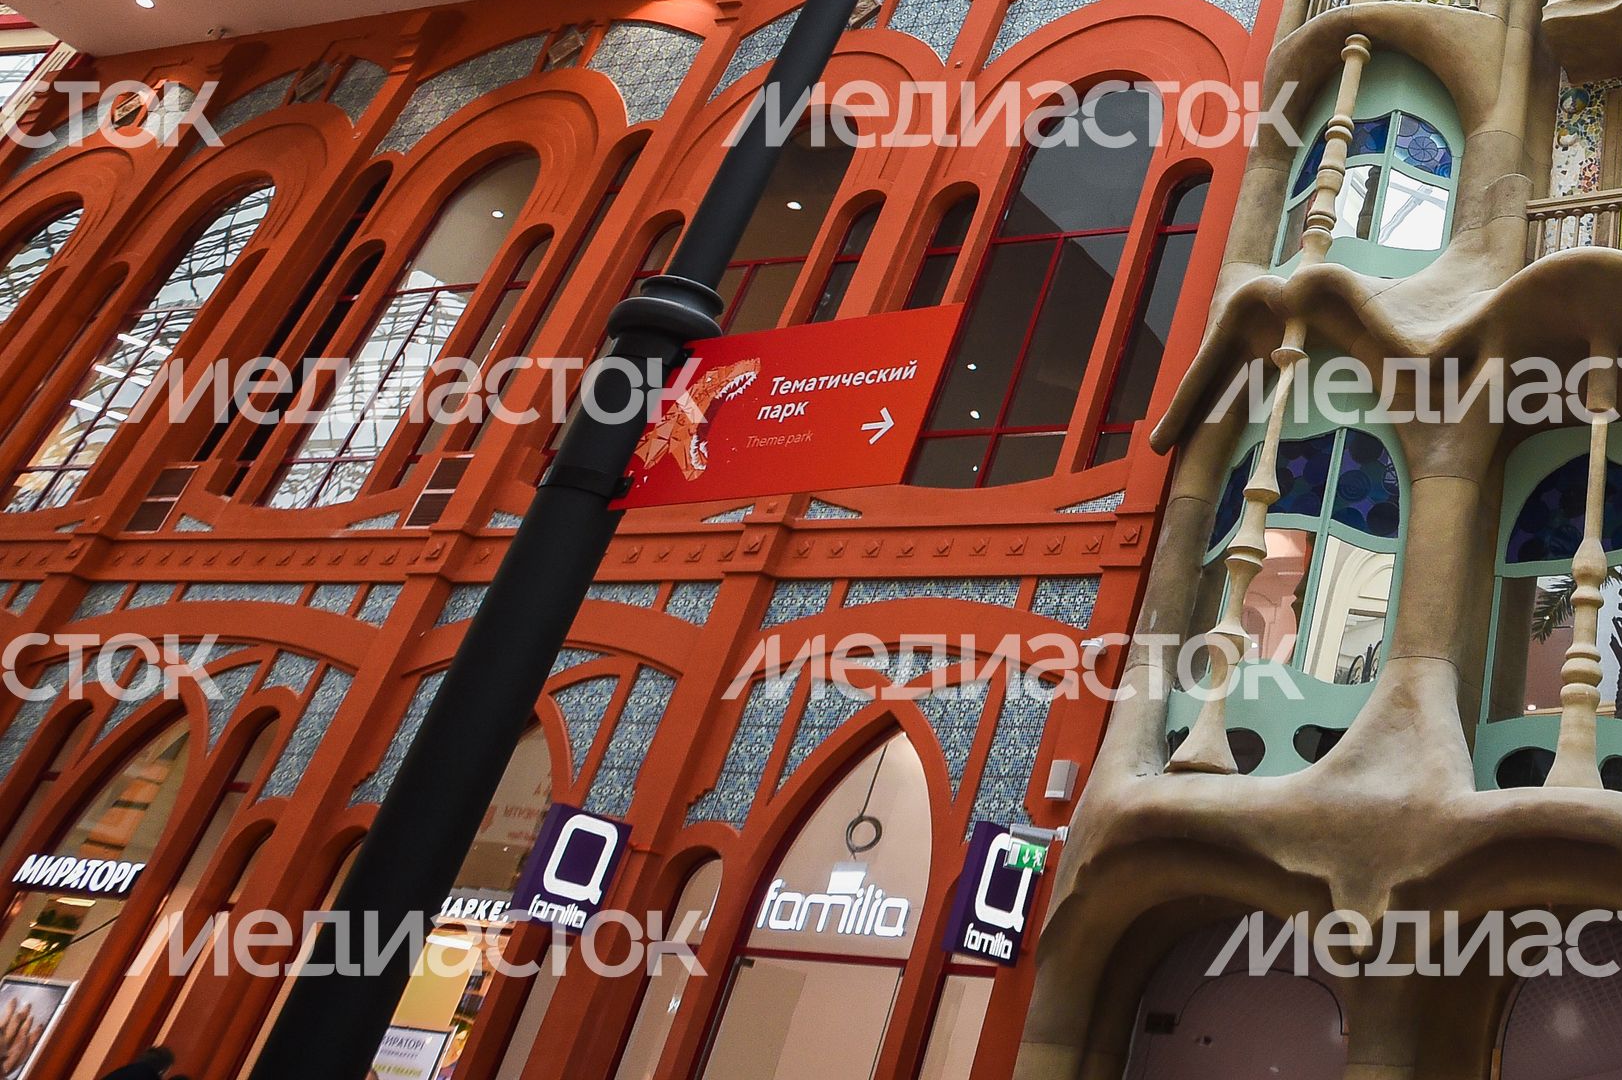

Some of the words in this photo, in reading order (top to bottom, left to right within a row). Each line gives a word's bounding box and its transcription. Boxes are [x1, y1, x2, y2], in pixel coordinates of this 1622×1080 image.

[770, 360, 918, 396] Тематический
[757, 400, 810, 423] парк
[745, 434, 785, 449] Theme
[785, 430, 814, 447] park
[12, 854, 147, 893] МИРАТОРГ
[527, 893, 588, 929] familia
[756, 878, 912, 938] familia
[963, 922, 1014, 960] familia
